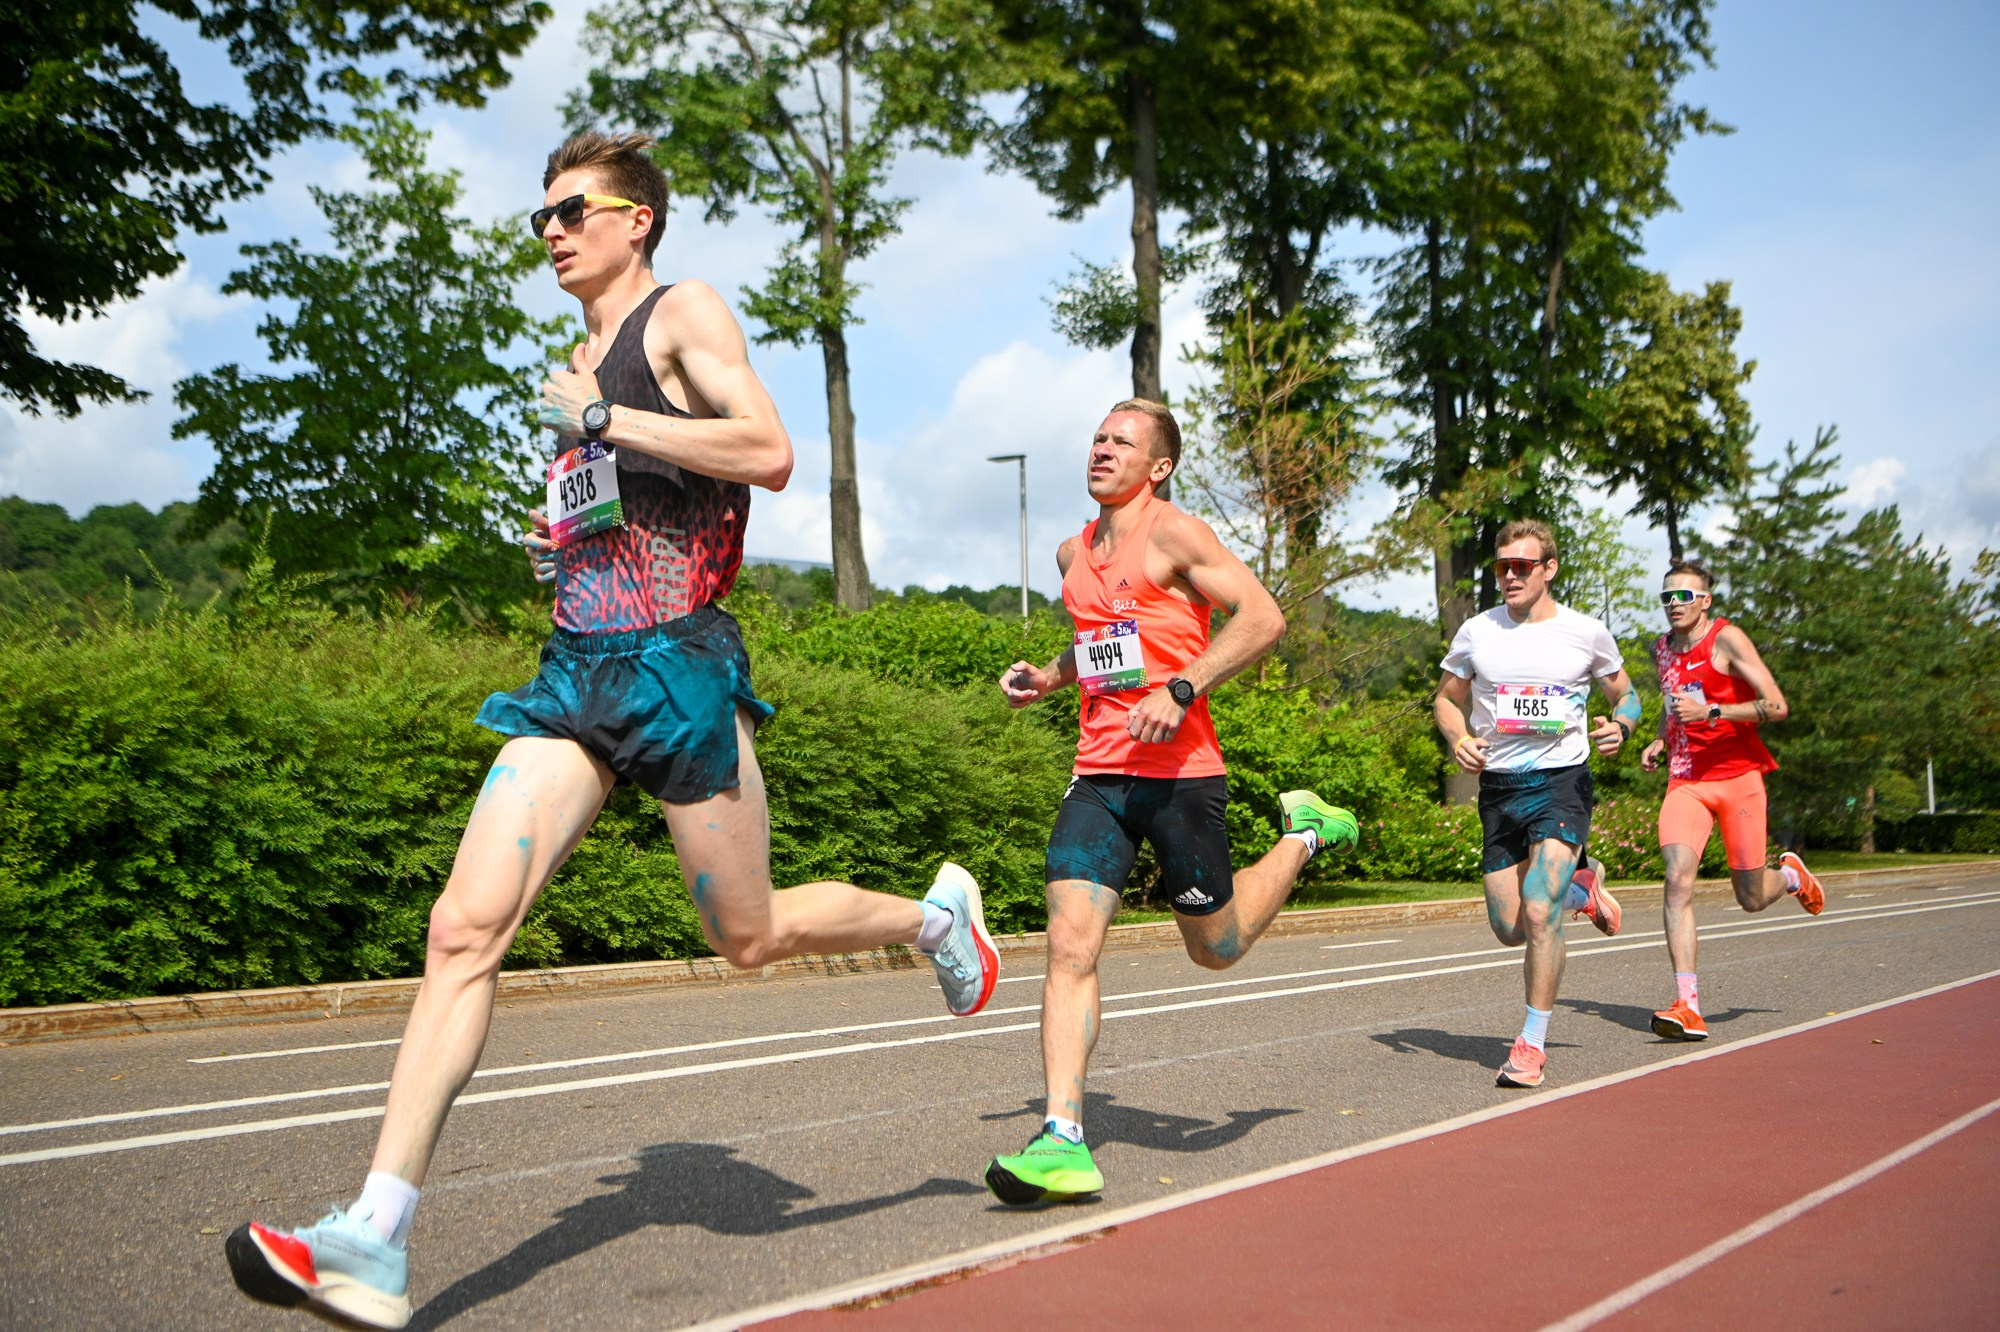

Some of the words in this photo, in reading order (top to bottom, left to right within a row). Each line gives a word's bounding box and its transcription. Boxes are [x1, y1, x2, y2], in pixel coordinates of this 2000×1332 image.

[560, 468, 597, 512] 4328
[1112, 599, 1139, 614] Bite
[1089, 641, 1124, 671] 4494
[1513, 697, 1549, 717] 4585
[1175, 895, 1213, 905] adidas
